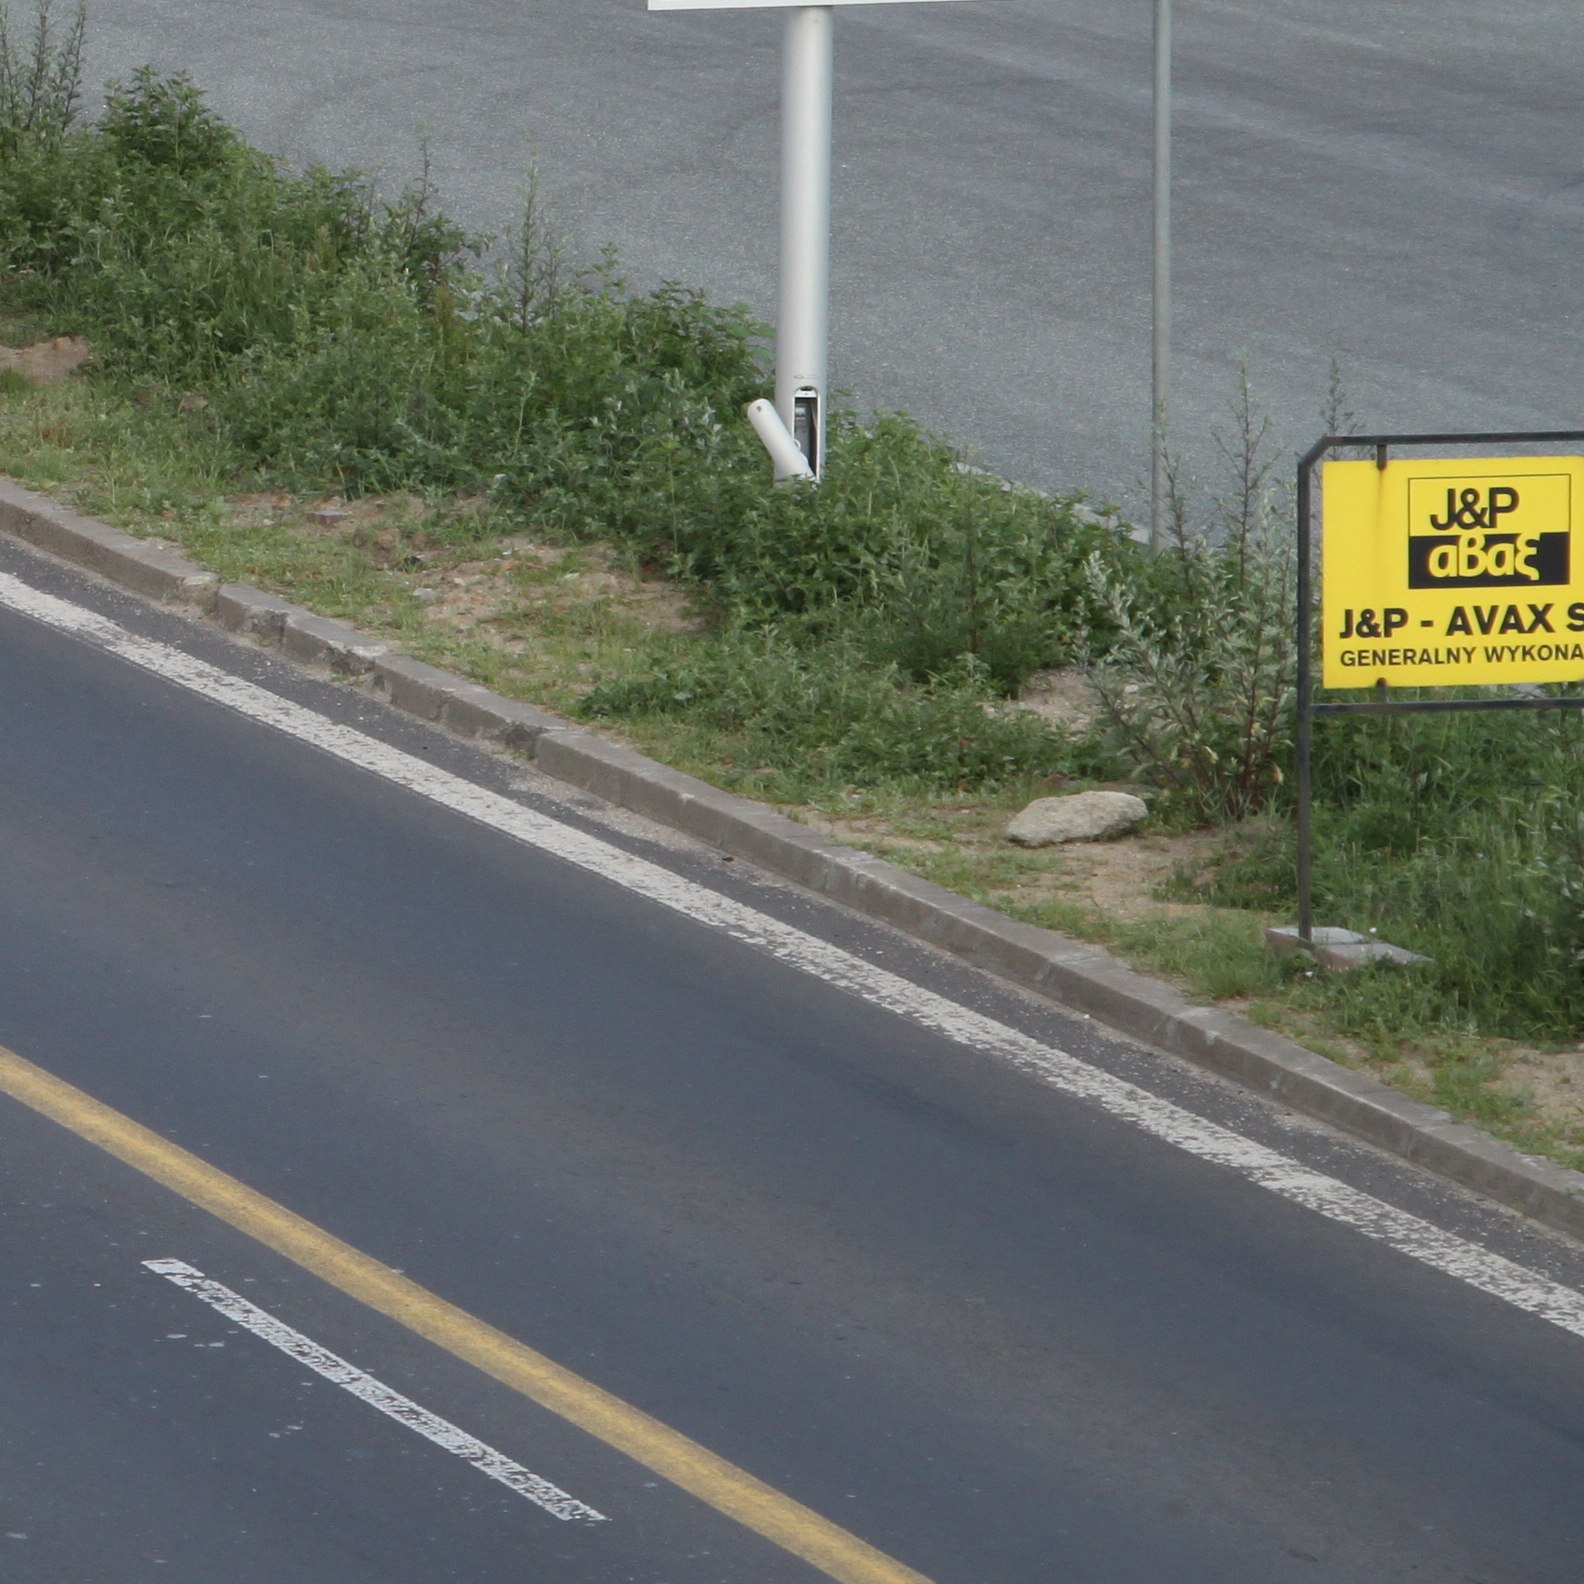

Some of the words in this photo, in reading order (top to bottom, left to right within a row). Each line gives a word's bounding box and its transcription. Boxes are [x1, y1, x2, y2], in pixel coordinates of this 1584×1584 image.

[1430, 486, 1520, 531] J&P
[1339, 607, 1410, 639] J&P
[1445, 602, 1557, 636] AVAX
[1340, 646, 1478, 668] GENERALNY
